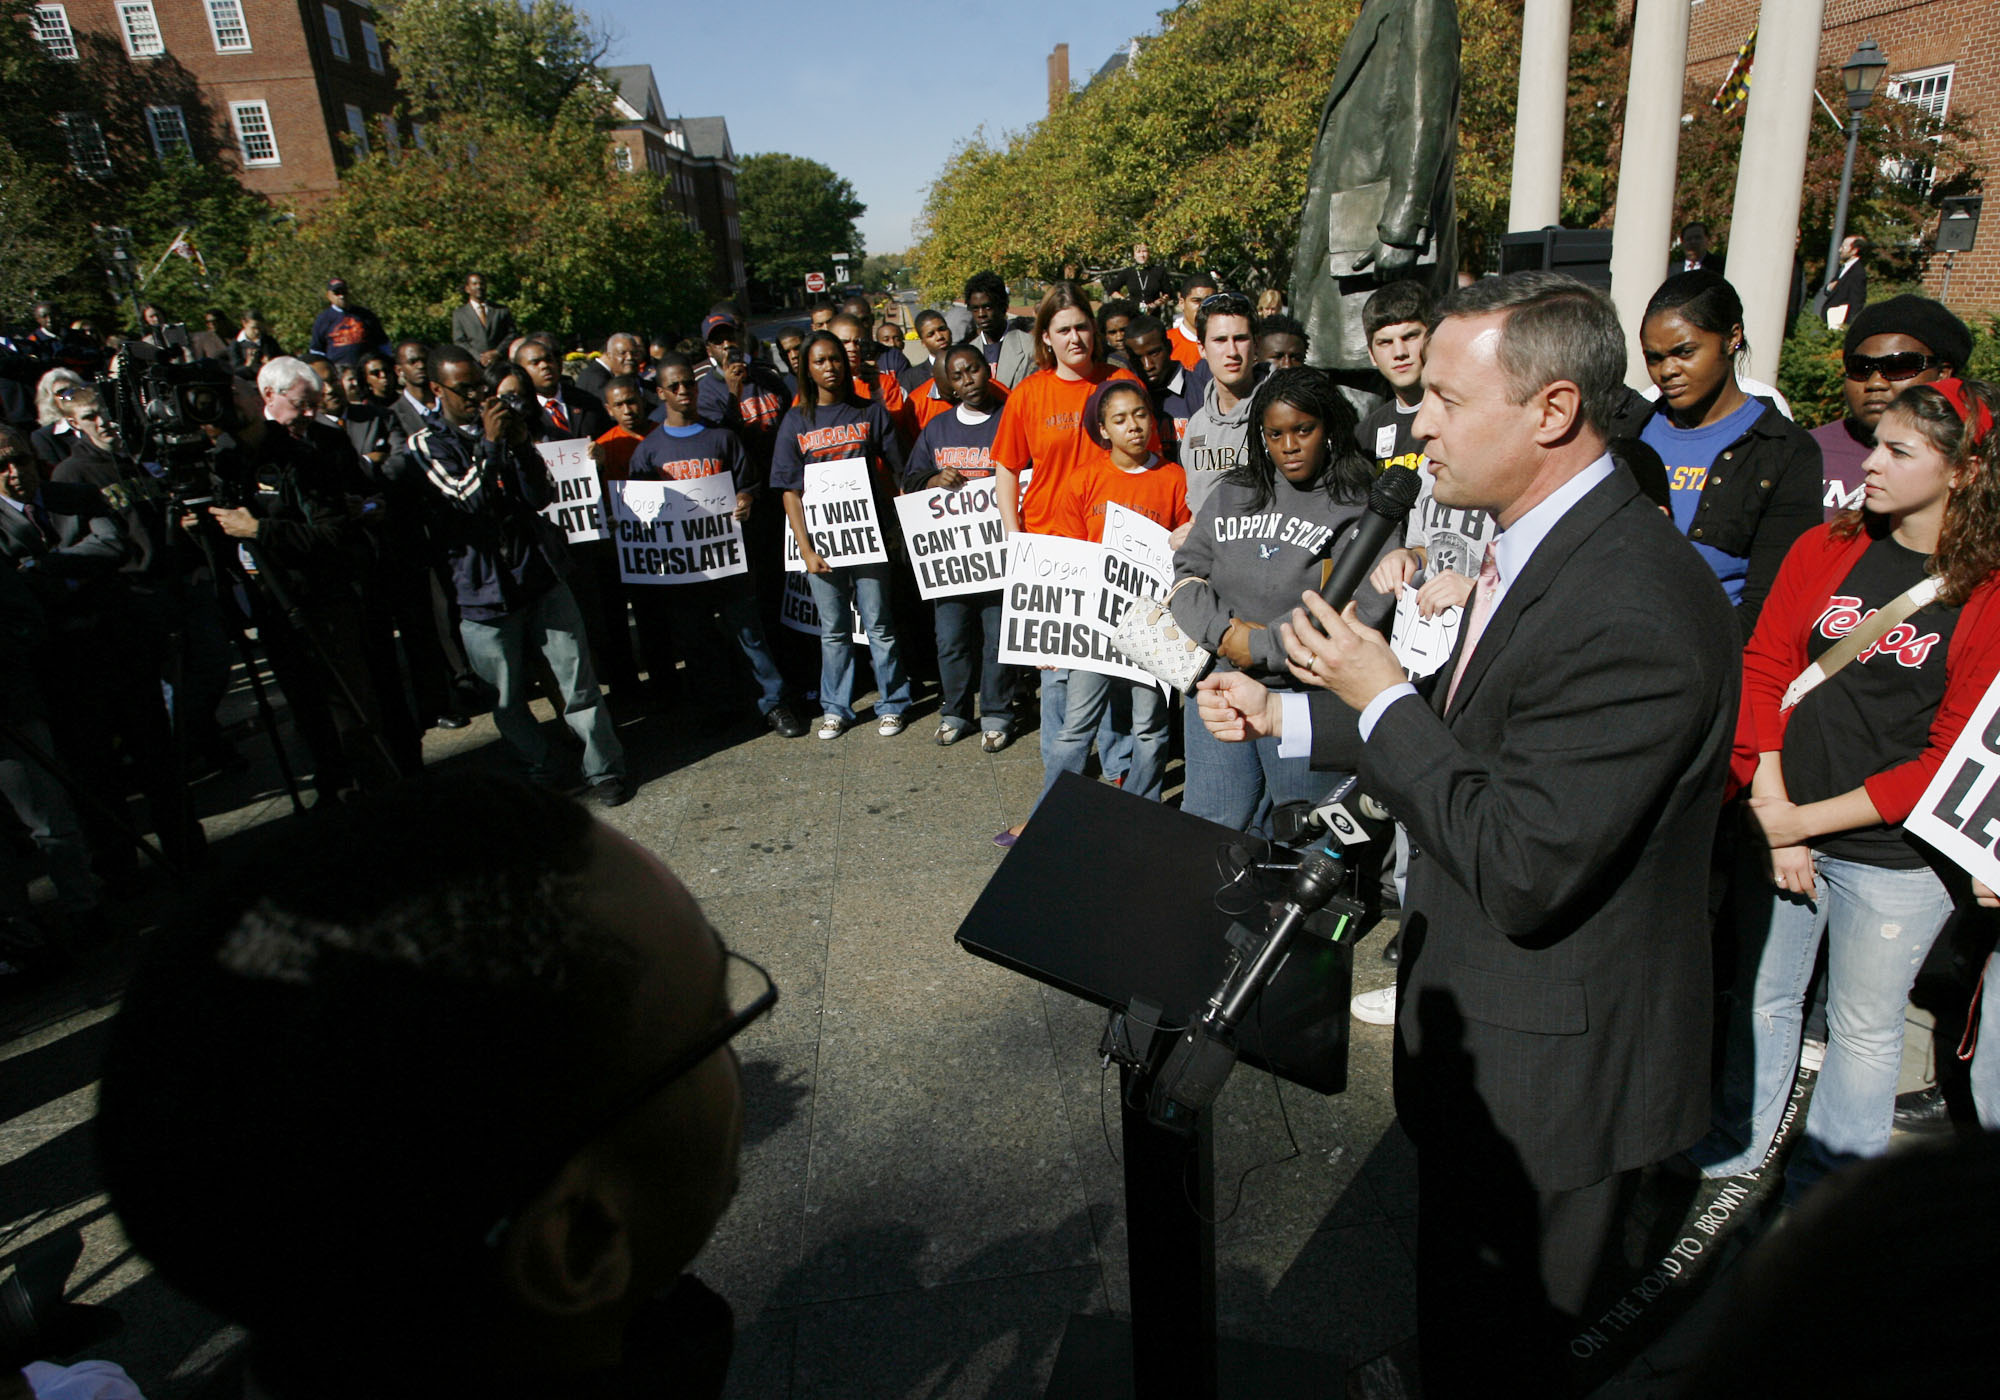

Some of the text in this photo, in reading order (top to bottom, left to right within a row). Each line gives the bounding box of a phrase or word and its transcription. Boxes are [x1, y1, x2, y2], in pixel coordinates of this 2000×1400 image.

[797, 421, 870, 454] MORGAN
[620, 511, 734, 543] CAN'T WAIT
[823, 498, 869, 525] WAIT
[912, 524, 972, 557] CAN'T
[1214, 512, 1334, 556] COPPIN STATE
[622, 538, 741, 576] LEGISLATE
[1012, 541, 1088, 580] Morgan
[1010, 582, 1085, 617] CAN'T
[1570, 1327, 1609, 1358] ON
[1600, 1297, 1644, 1332] THE
[1632, 1257, 1682, 1304] ROAD
[1672, 1237, 1703, 1261] TO
[1694, 1181, 1749, 1236] BROWN
